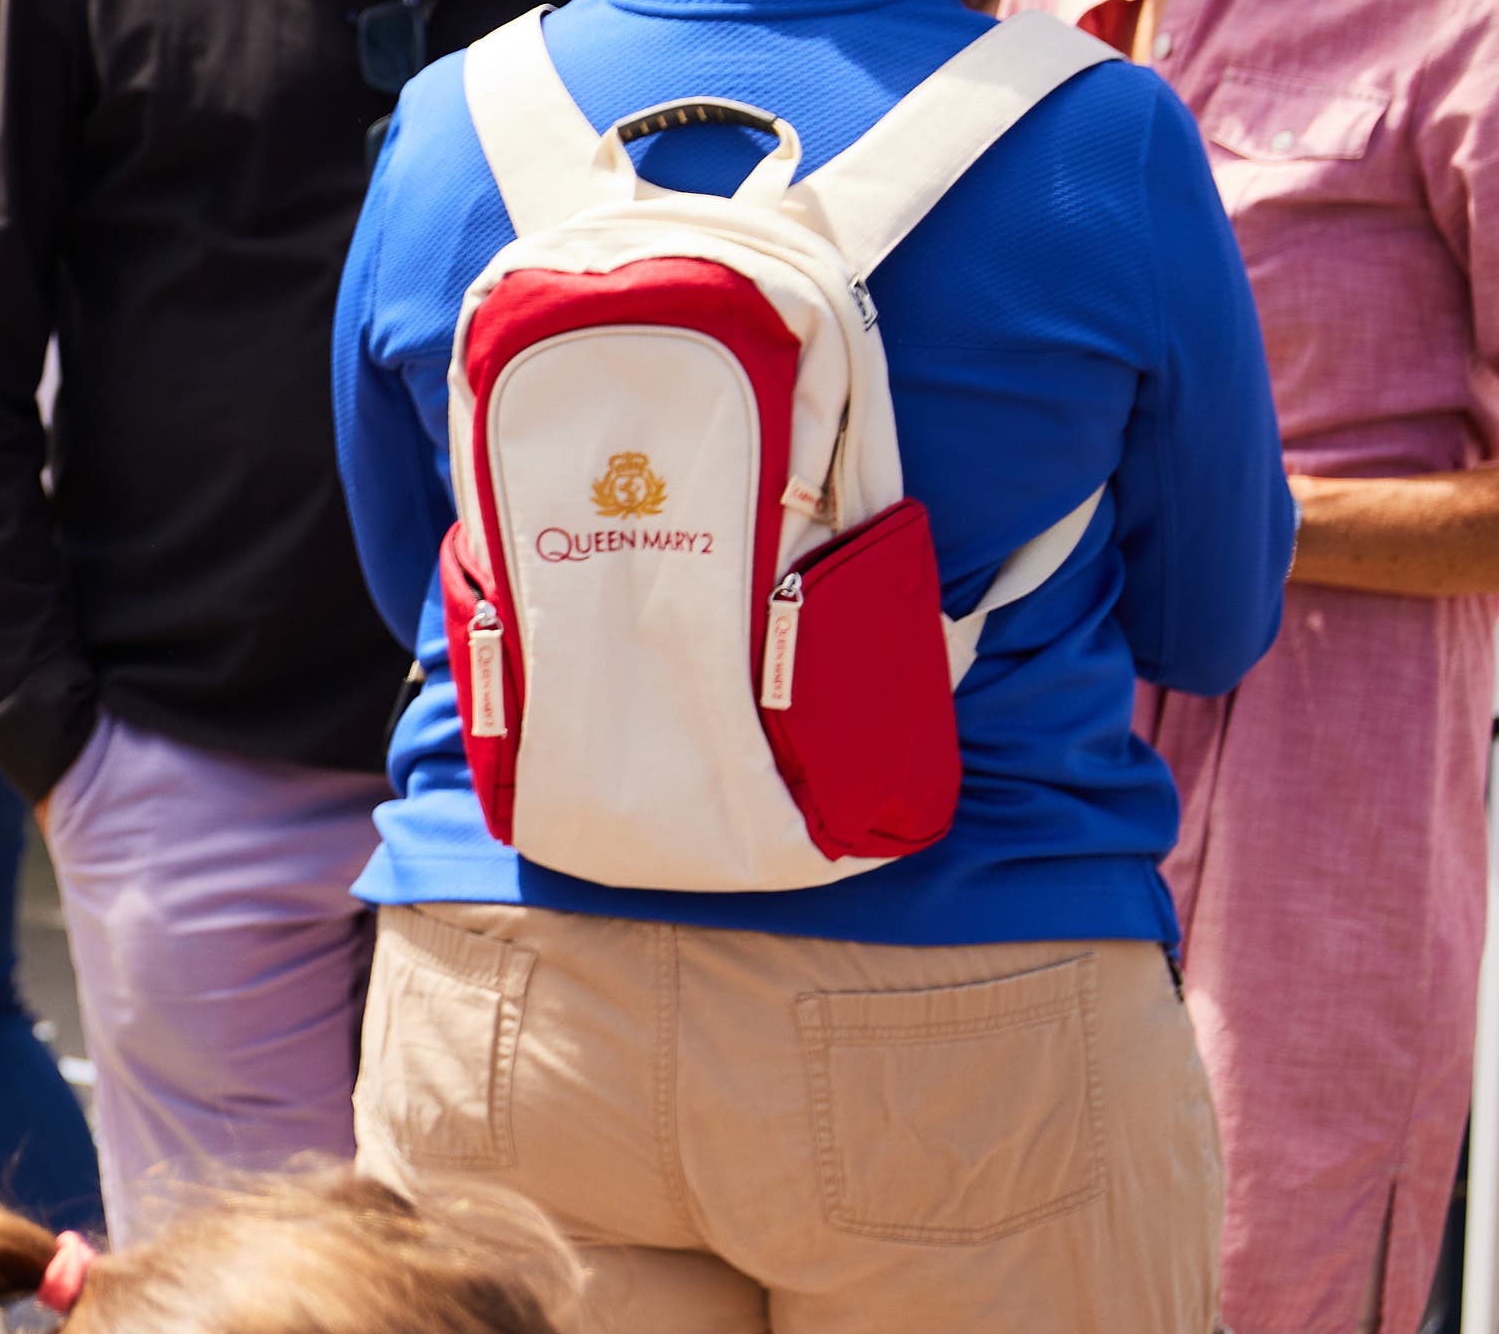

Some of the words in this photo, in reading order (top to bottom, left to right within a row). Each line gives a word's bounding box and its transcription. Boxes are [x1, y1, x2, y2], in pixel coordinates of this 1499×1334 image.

[536, 527, 636, 562] QUEEN
[642, 529, 697, 552] MARY
[701, 532, 714, 554] 2
